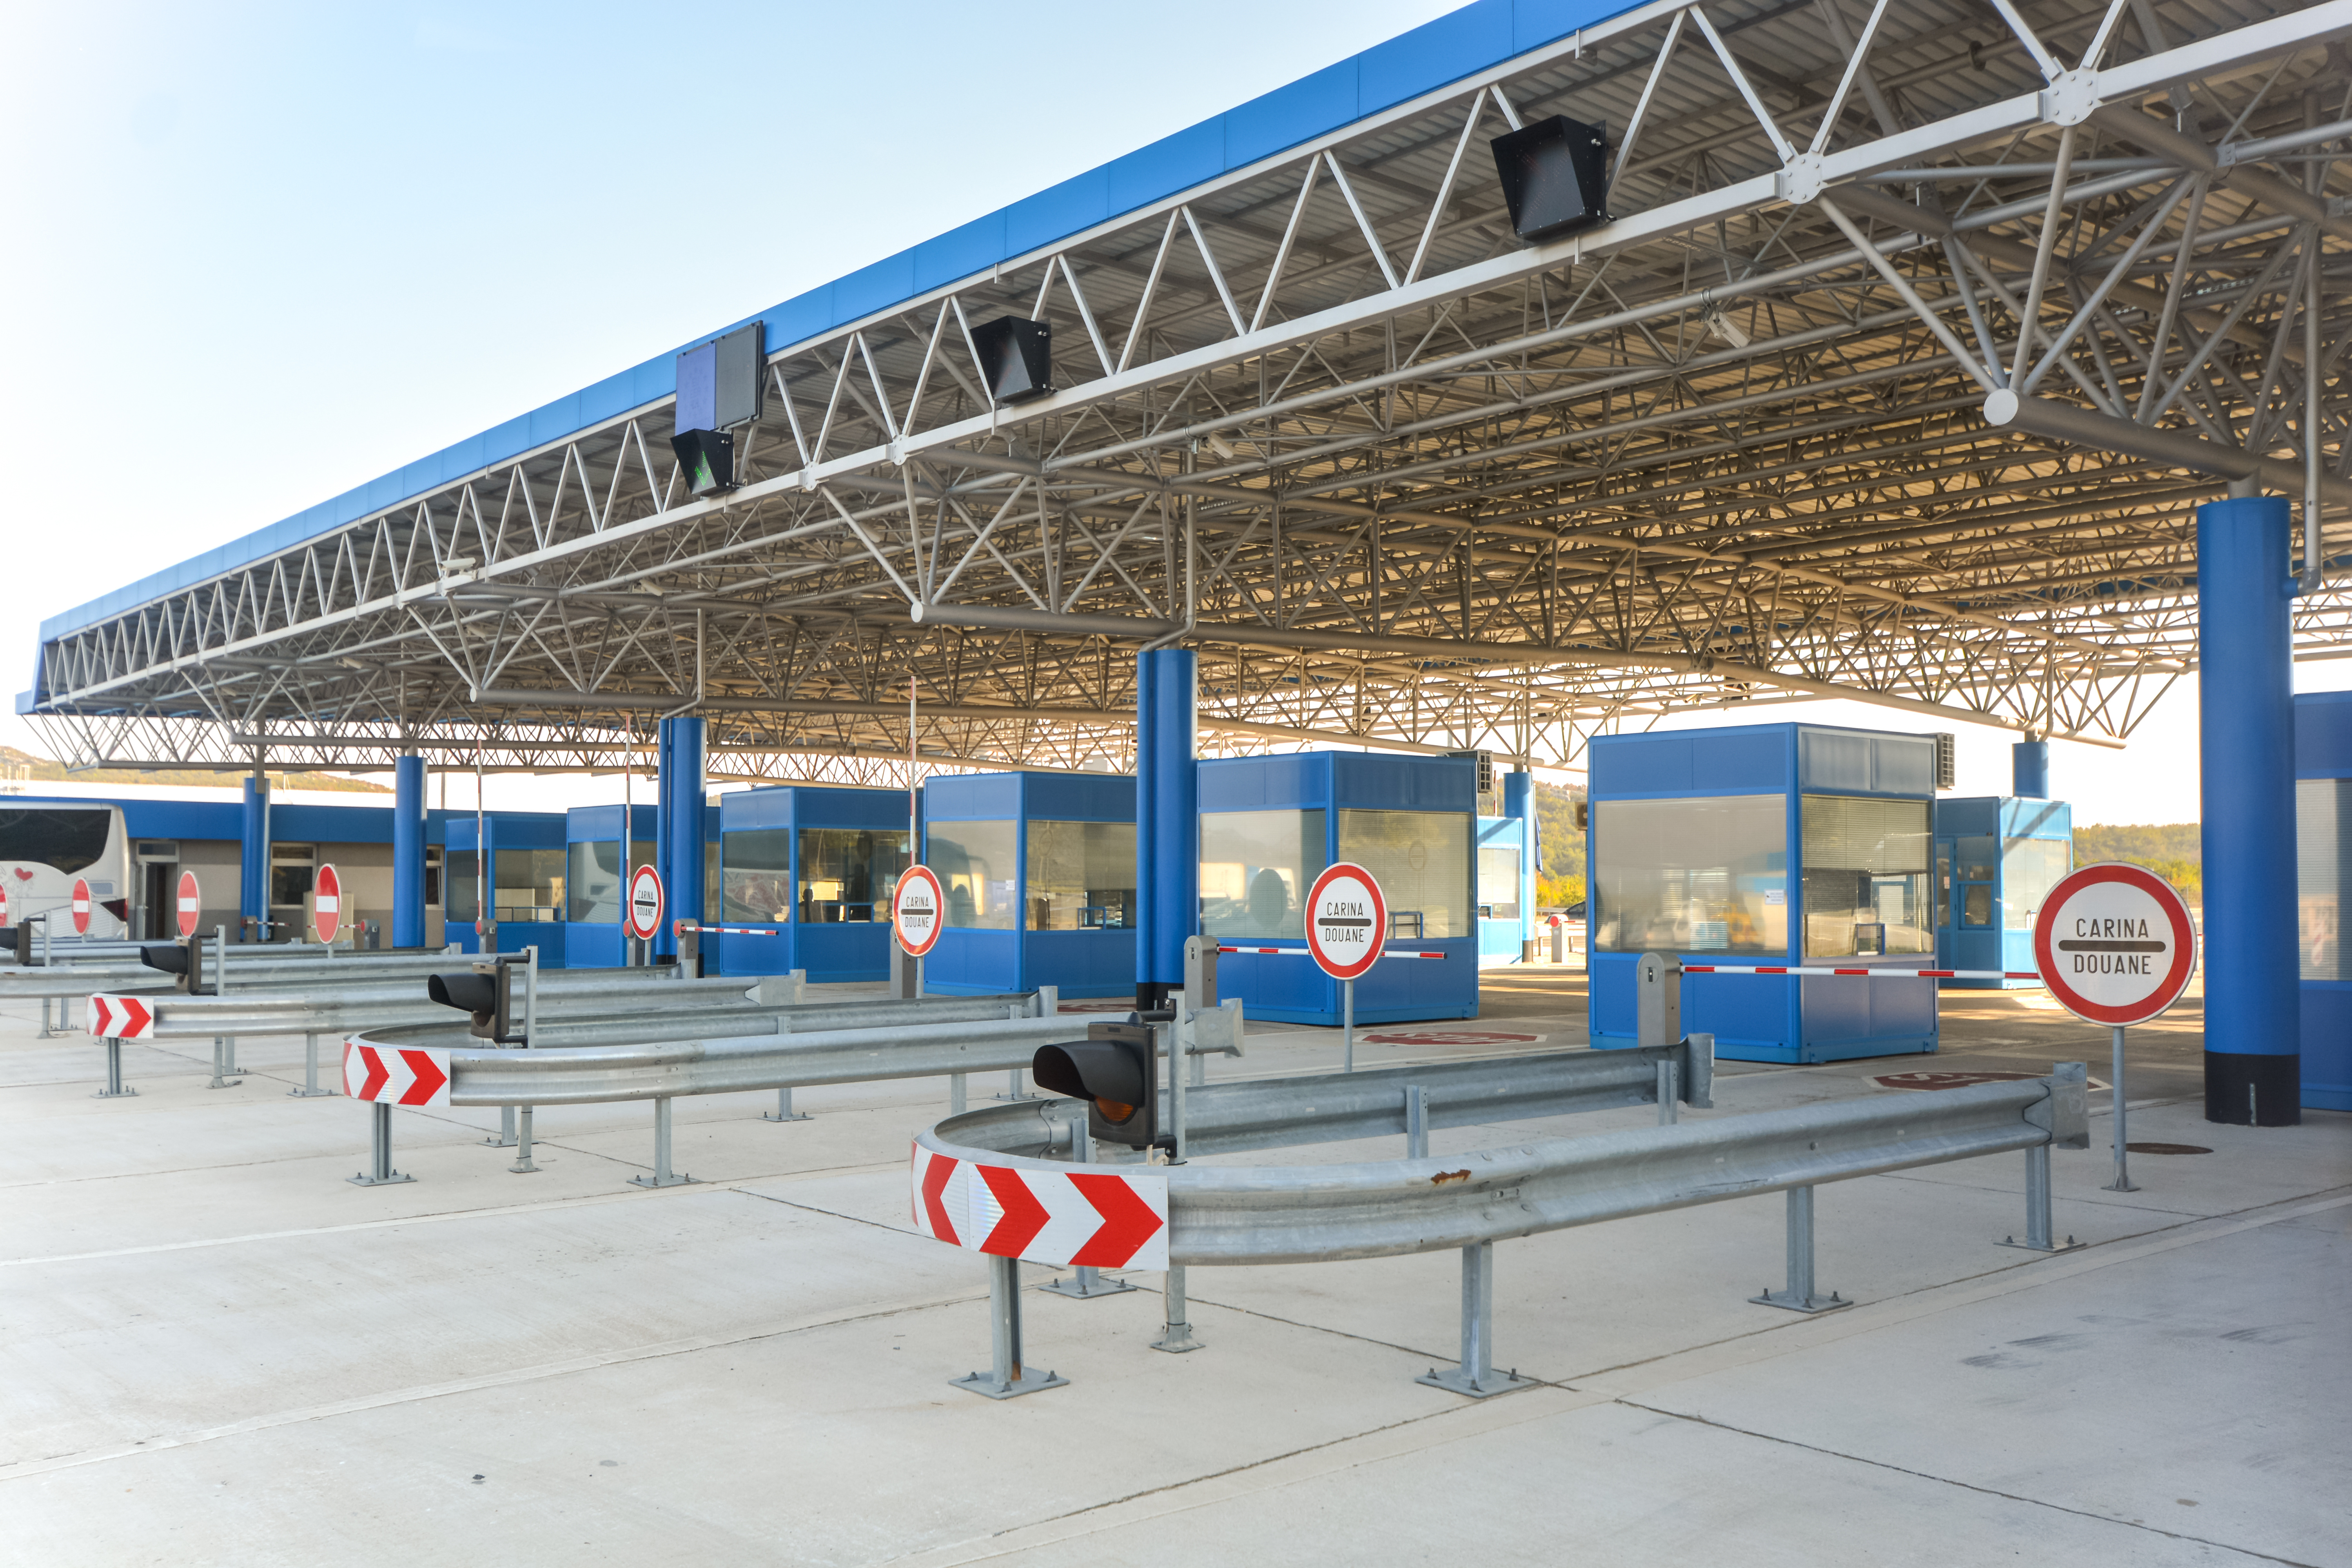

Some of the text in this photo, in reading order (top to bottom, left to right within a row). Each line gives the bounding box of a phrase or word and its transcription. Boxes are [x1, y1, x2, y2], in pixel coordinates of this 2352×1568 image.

[638, 890, 653, 900] CARINA
[906, 897, 929, 907] CARINA
[637, 907, 653, 917] DOUANE
[1327, 902, 1363, 916] CARINA
[905, 917, 929, 927] DOUANE
[2076, 918, 2149, 938] CARINA
[1325, 928, 1364, 942] DOUANE
[2074, 955, 2151, 975] DOUANE
